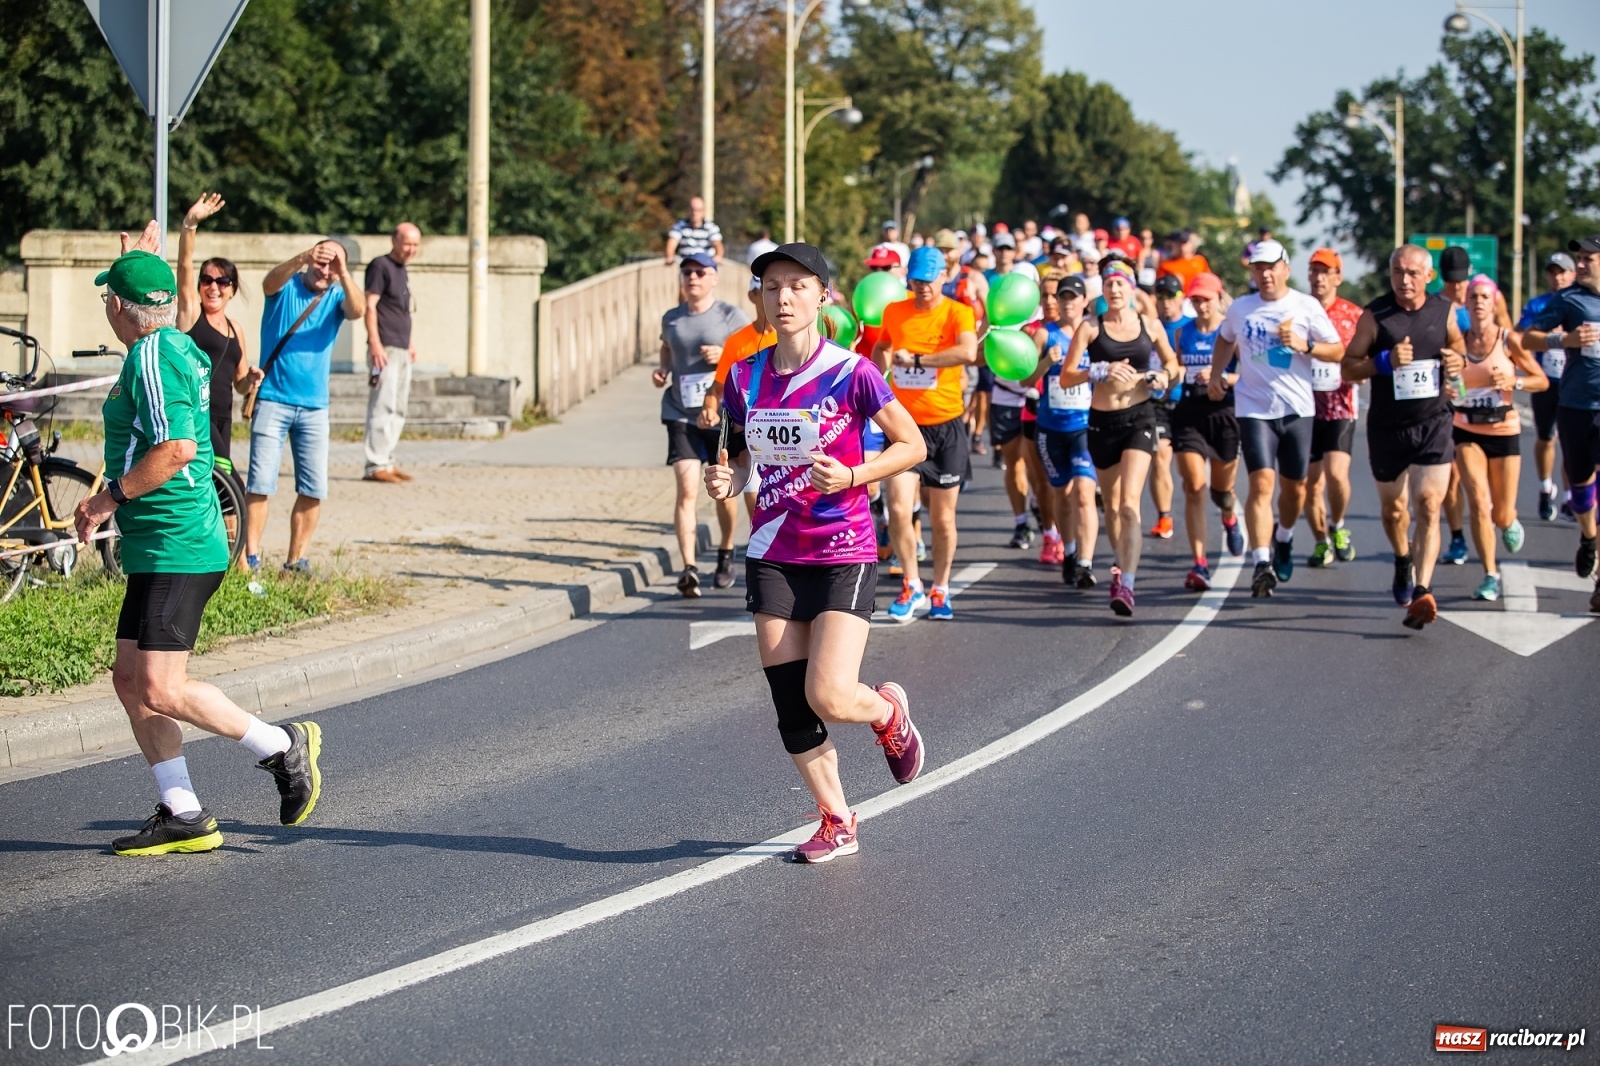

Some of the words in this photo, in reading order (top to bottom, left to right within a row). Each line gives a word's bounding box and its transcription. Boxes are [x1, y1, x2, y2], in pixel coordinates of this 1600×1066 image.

[1413, 372, 1428, 384] 26
[766, 425, 802, 445] 405
[819, 412, 853, 449] CIBÓRZ
